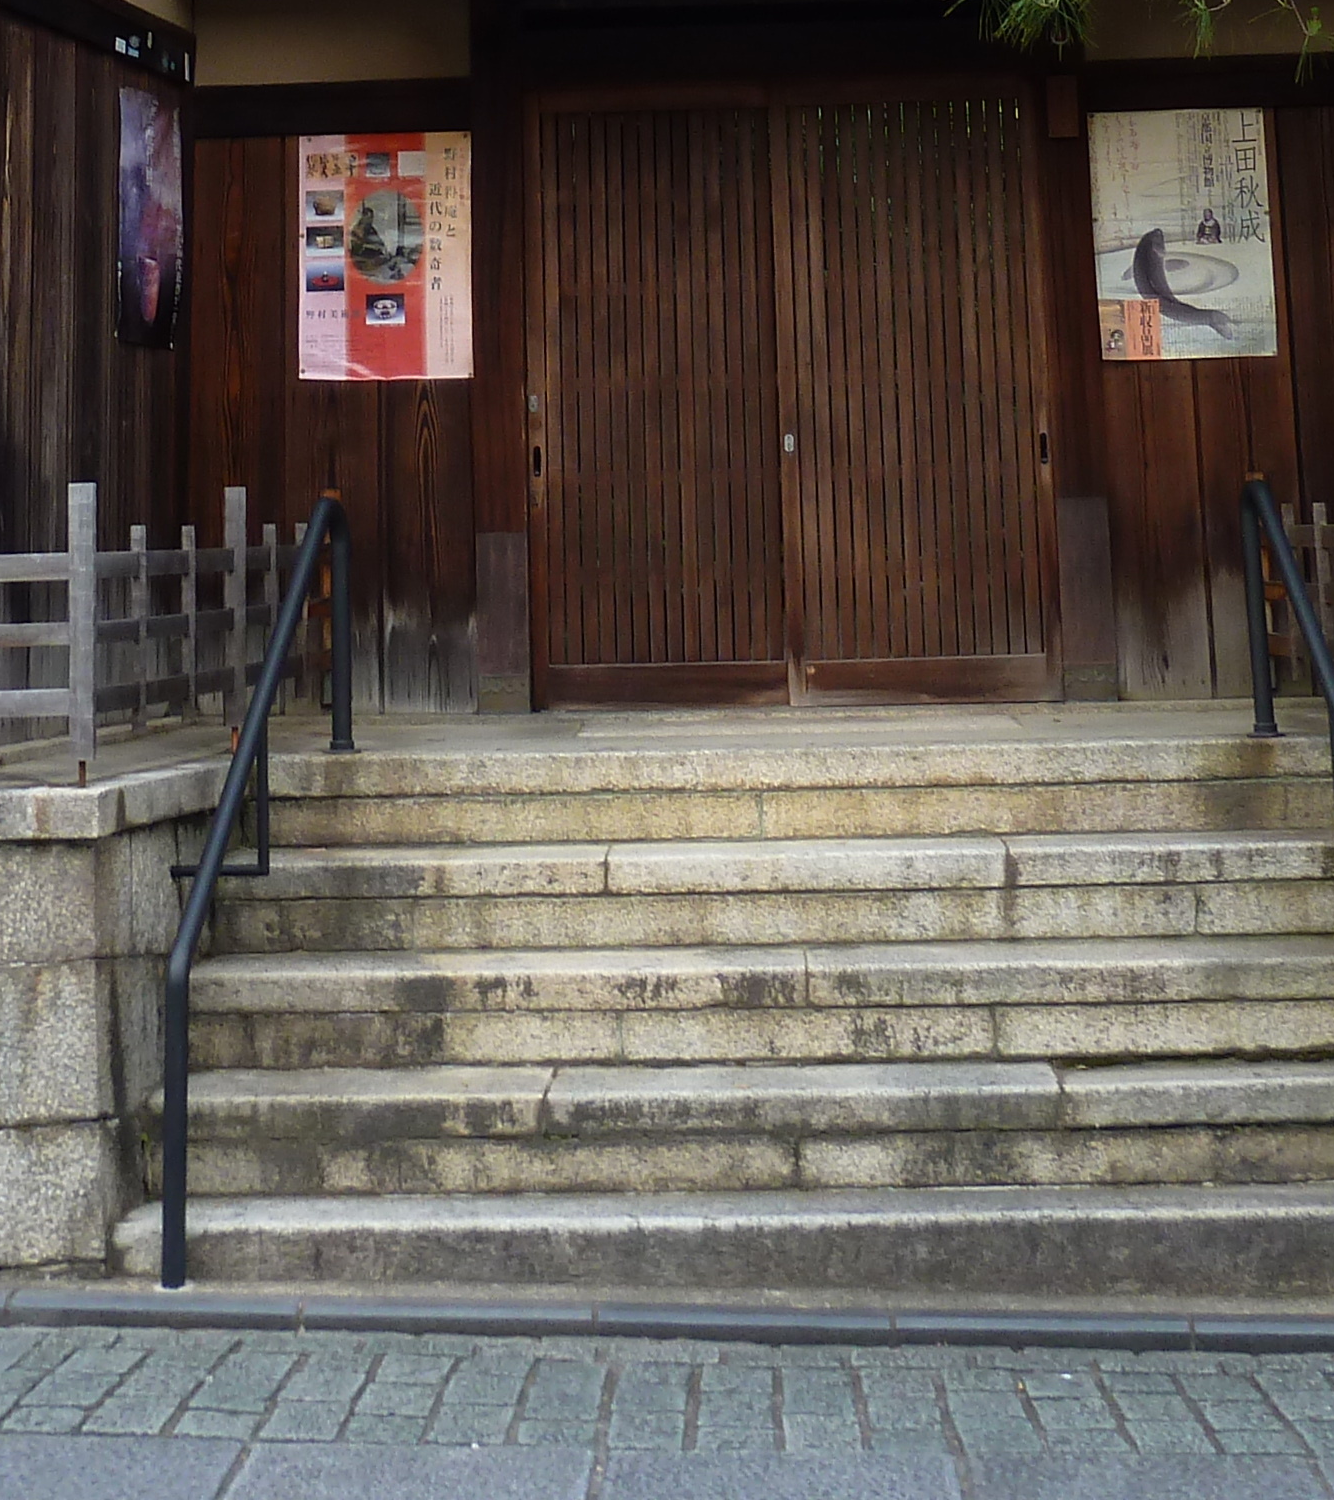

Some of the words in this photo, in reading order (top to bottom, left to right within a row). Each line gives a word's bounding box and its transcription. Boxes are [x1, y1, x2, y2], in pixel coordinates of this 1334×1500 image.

[429, 182, 443, 291] 近代の数奇者
[1232, 111, 1265, 243] 上田秋成
